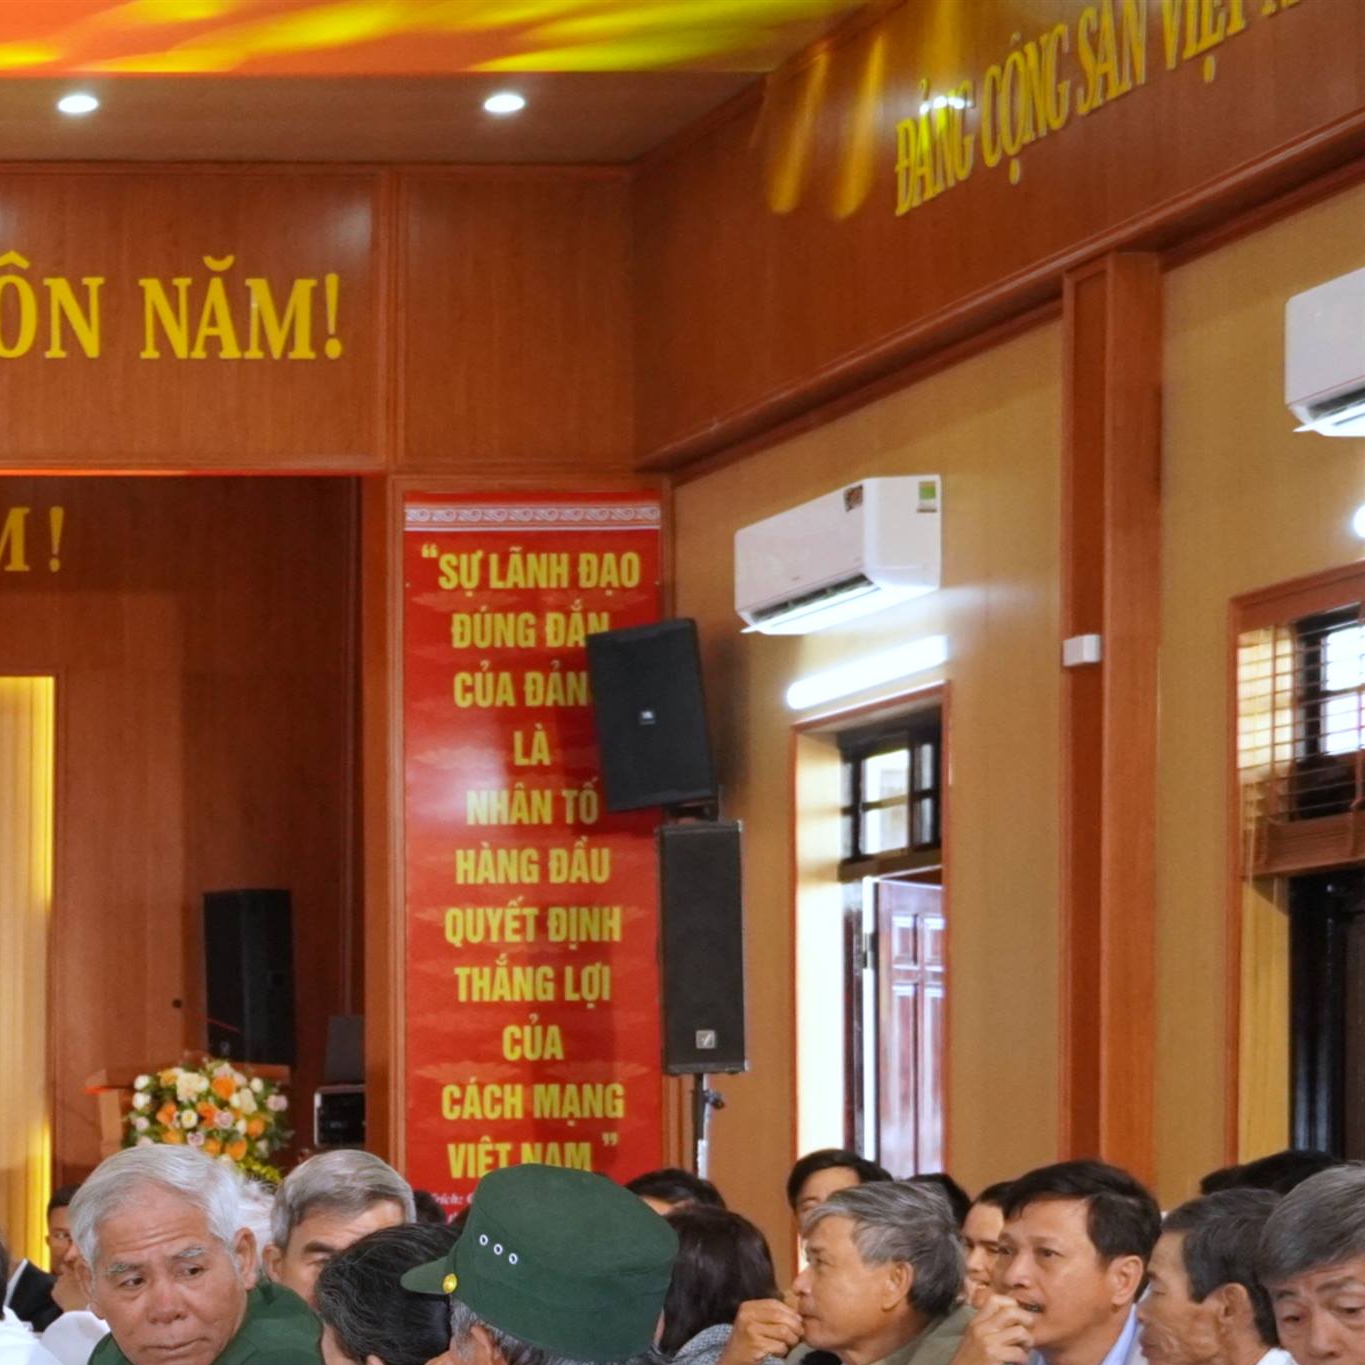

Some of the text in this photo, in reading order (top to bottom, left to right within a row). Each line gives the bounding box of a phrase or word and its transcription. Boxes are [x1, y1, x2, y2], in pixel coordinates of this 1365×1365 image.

[982, 24, 1070, 185] CỘNG
[138, 255, 344, 360] NĂM!
[489, 546, 569, 589] LÃNH
[578, 552, 641, 596] ĐẠO
[451, 605, 536, 649] ĐÚNG
[453, 660, 589, 709] CỦA ĐẢN
[513, 722, 551, 766] LÀ
[466, 777, 600, 825] NHÂN TỐ
[454, 836, 611, 885] HÀNG ĐẦU
[443, 895, 623, 950] QUYẾT ĐỊNH
[453, 952, 611, 1009] THẮNG LỢI
[502, 1013, 565, 1062] CỦA
[441, 1076, 625, 1126] CÁCH MẠNG
